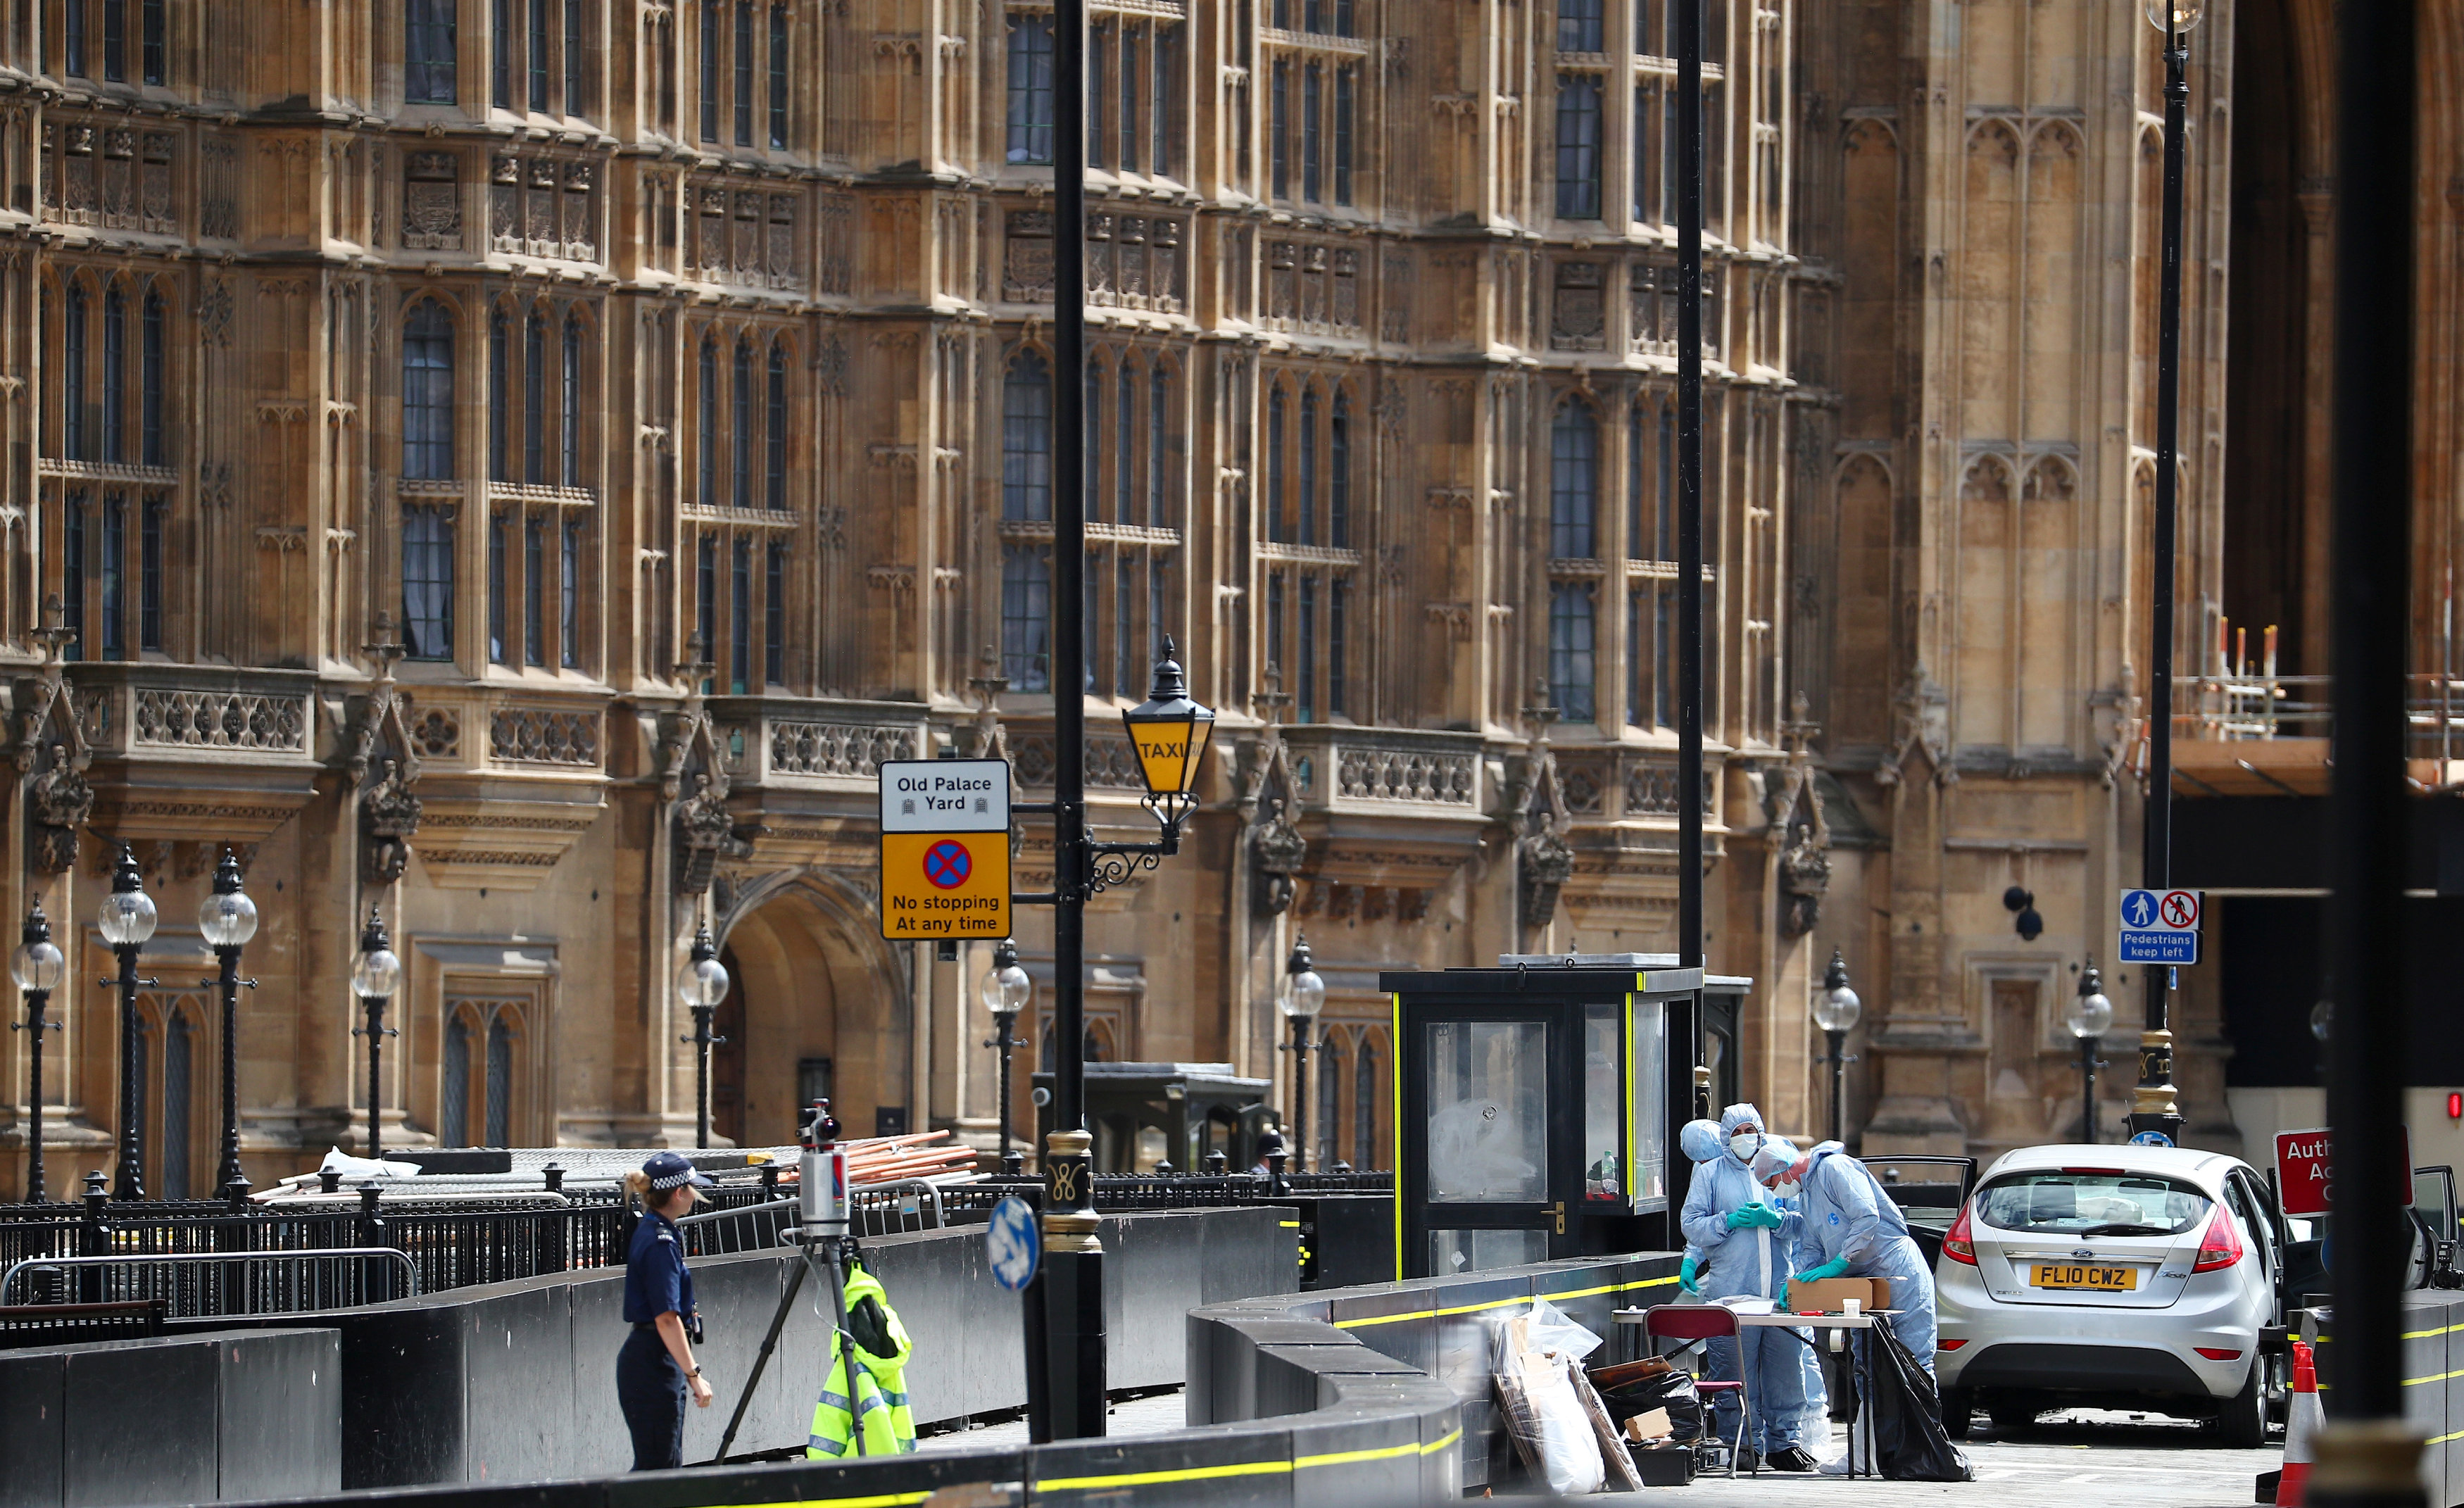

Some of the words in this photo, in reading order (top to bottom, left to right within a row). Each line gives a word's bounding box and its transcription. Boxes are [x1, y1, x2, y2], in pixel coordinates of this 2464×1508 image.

[1140, 742, 1184, 758] TAXI
[898, 777, 927, 791] Old
[935, 777, 991, 791] Palace
[926, 796, 964, 810] Yard
[893, 896, 917, 909] No
[924, 895, 999, 911] stopping
[896, 917, 916, 930] At
[922, 919, 952, 933] any
[960, 916, 997, 929] time
[2124, 934, 2190, 945] Pedestrians
[2131, 947, 2158, 957] keep
[2163, 947, 2183, 957] left
[2041, 1267, 2083, 1283] FL10
[2088, 1268, 2125, 1286] CWZ
